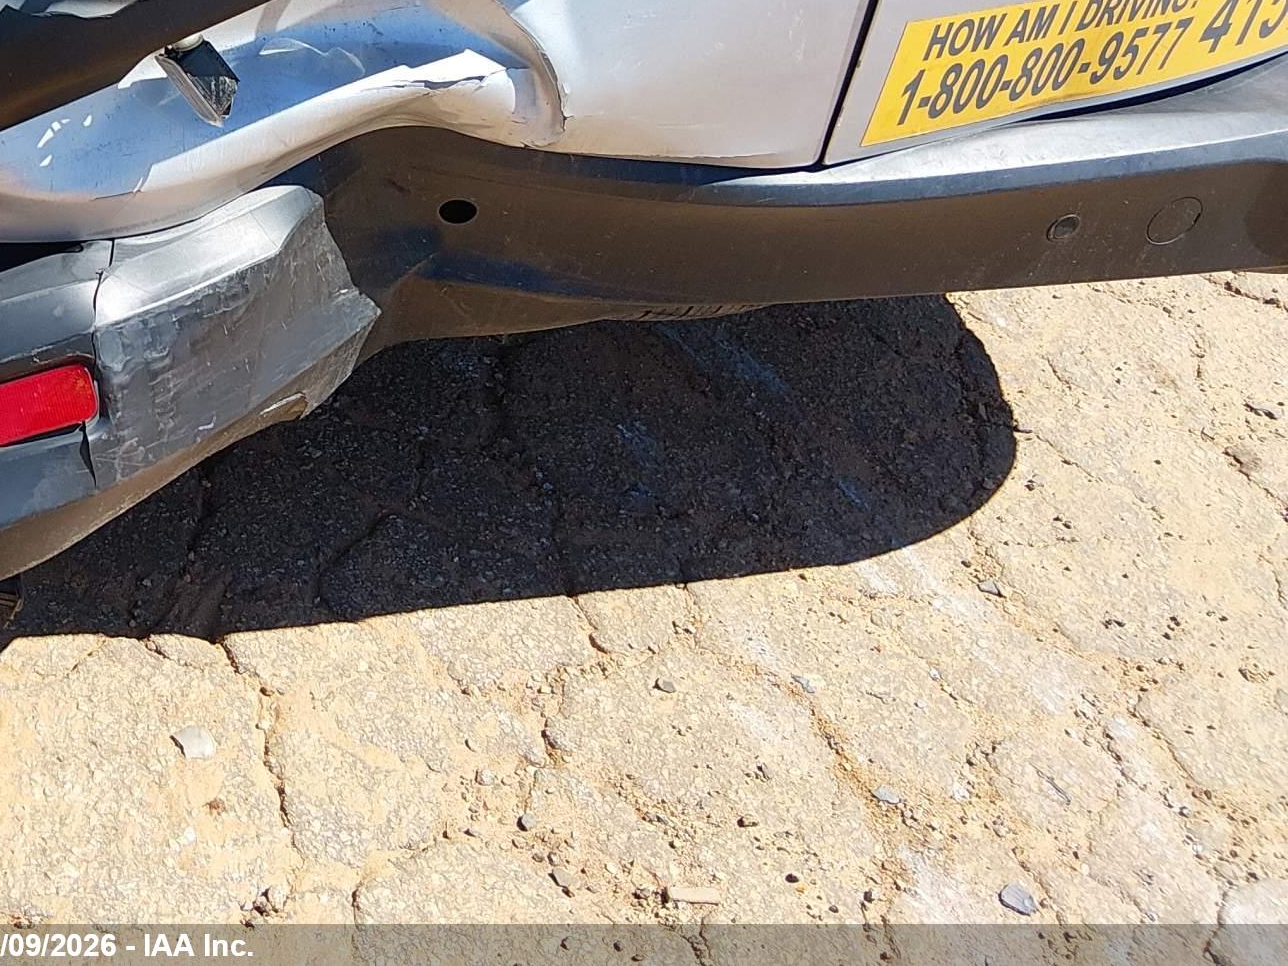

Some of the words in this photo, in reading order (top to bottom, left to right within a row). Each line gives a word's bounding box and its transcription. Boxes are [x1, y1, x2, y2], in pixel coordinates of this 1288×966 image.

[897, 16, 1195, 126] 1-800-800-9577
[922, 13, 1008, 61] HOW
[1004, 4, 1058, 48] AM
[1058, 0, 1078, 35] I
